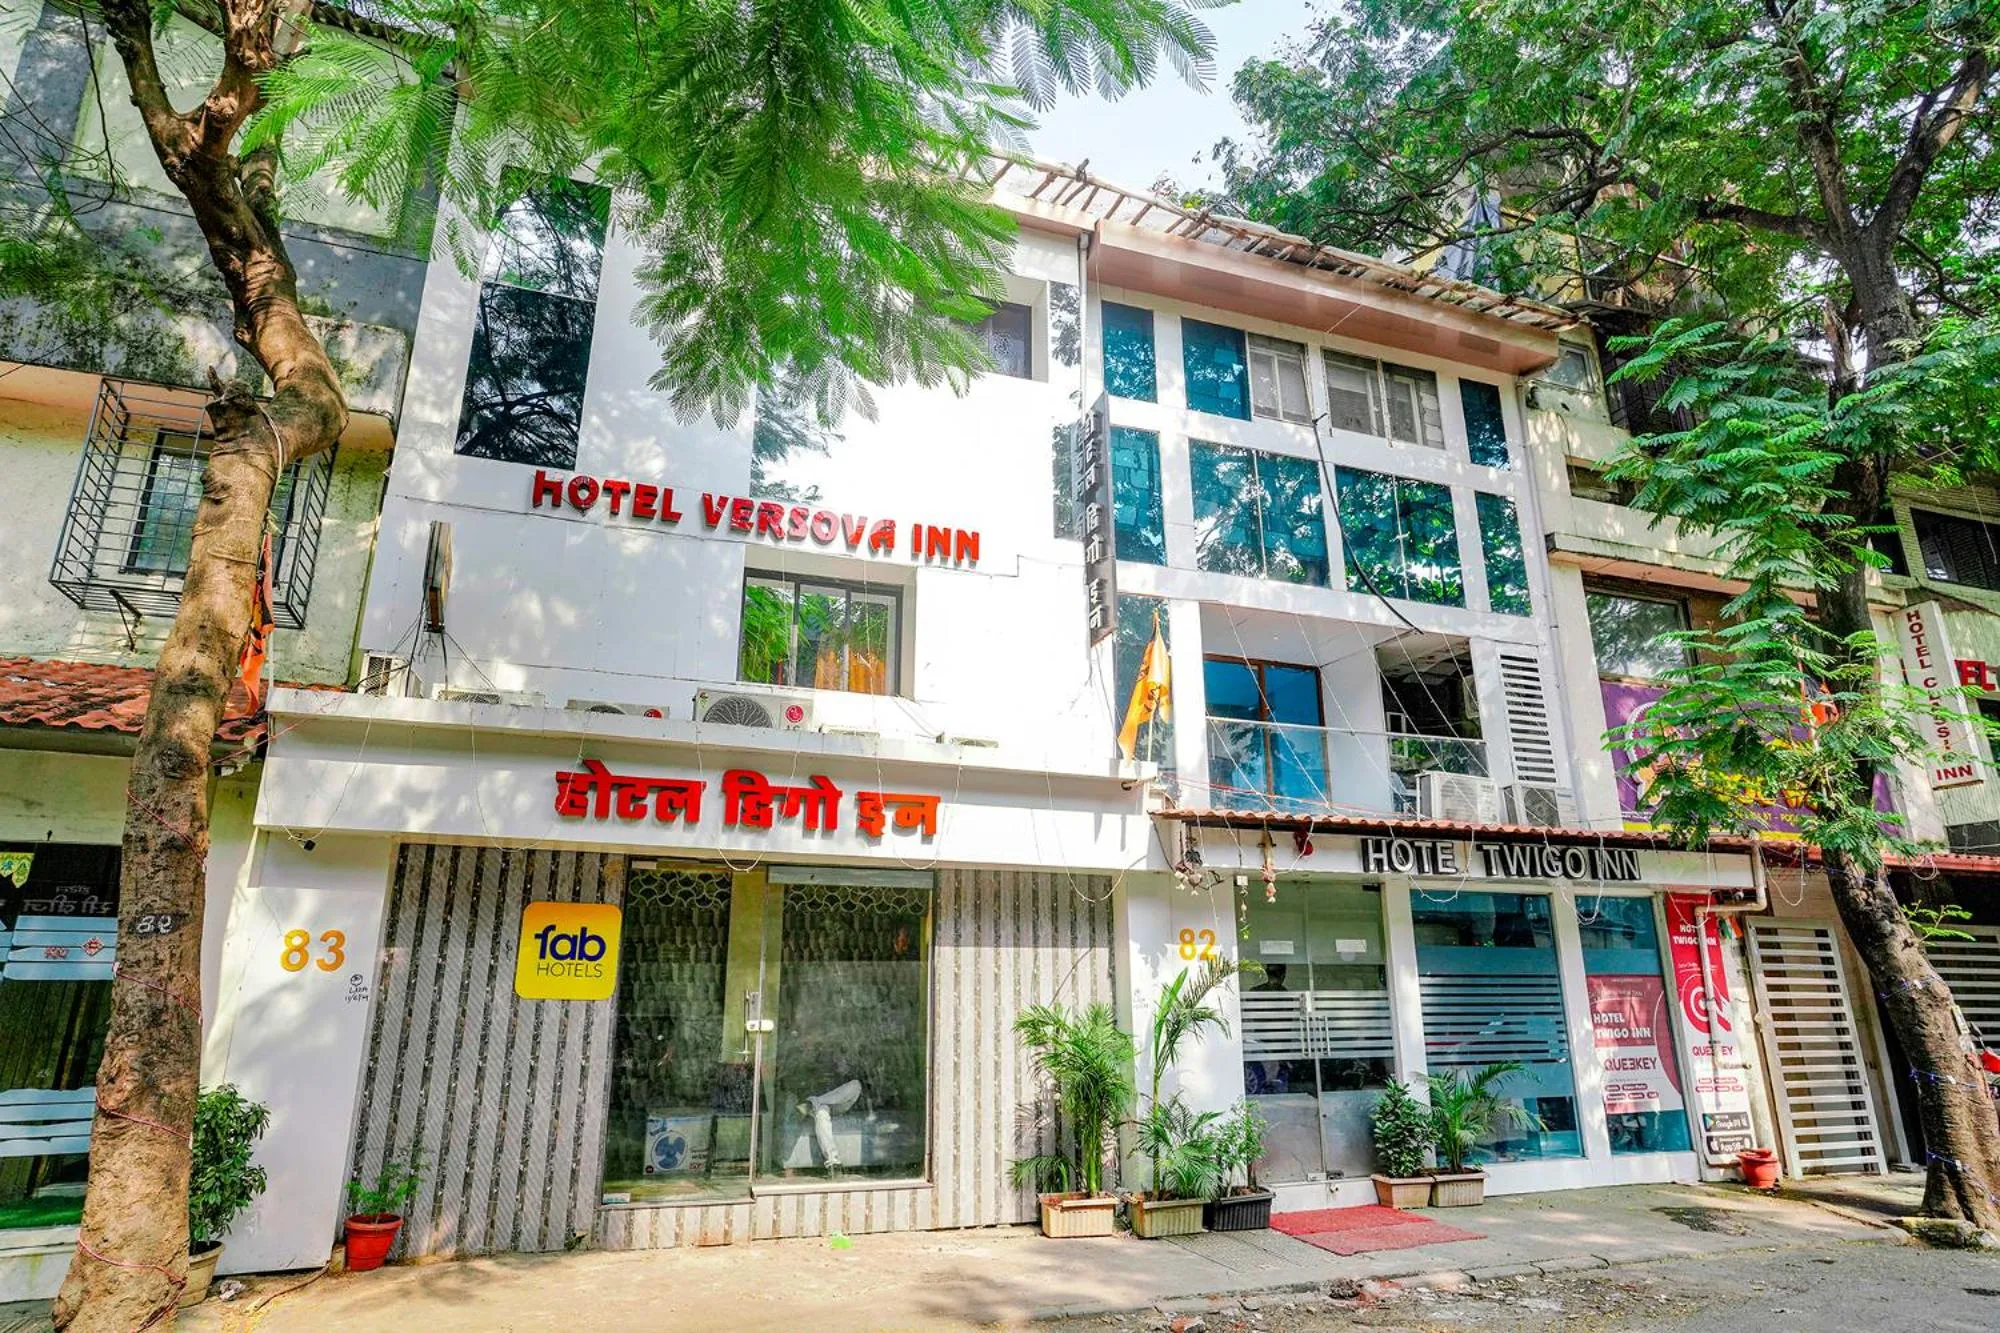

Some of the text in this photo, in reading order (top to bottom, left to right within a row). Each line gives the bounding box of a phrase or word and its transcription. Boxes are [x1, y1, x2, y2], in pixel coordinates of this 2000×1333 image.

[532, 469, 981, 564] HOTEL VERSOVA INN
[1905, 609, 1933, 670] HOTEL
[1936, 764, 1973, 781] INN
[554, 758, 708, 825] होटल
[856, 790, 942, 838] इन
[1361, 838, 1642, 881] HOTE TWIGO INN
[280, 928, 346, 973] 83
[534, 924, 607, 962] fab
[1178, 928, 1217, 962] 82
[536, 962, 604, 978] HOTELS
[1592, 1012, 1626, 1025] HOTEL
[1595, 1027, 1652, 1040] TWIGO INN
